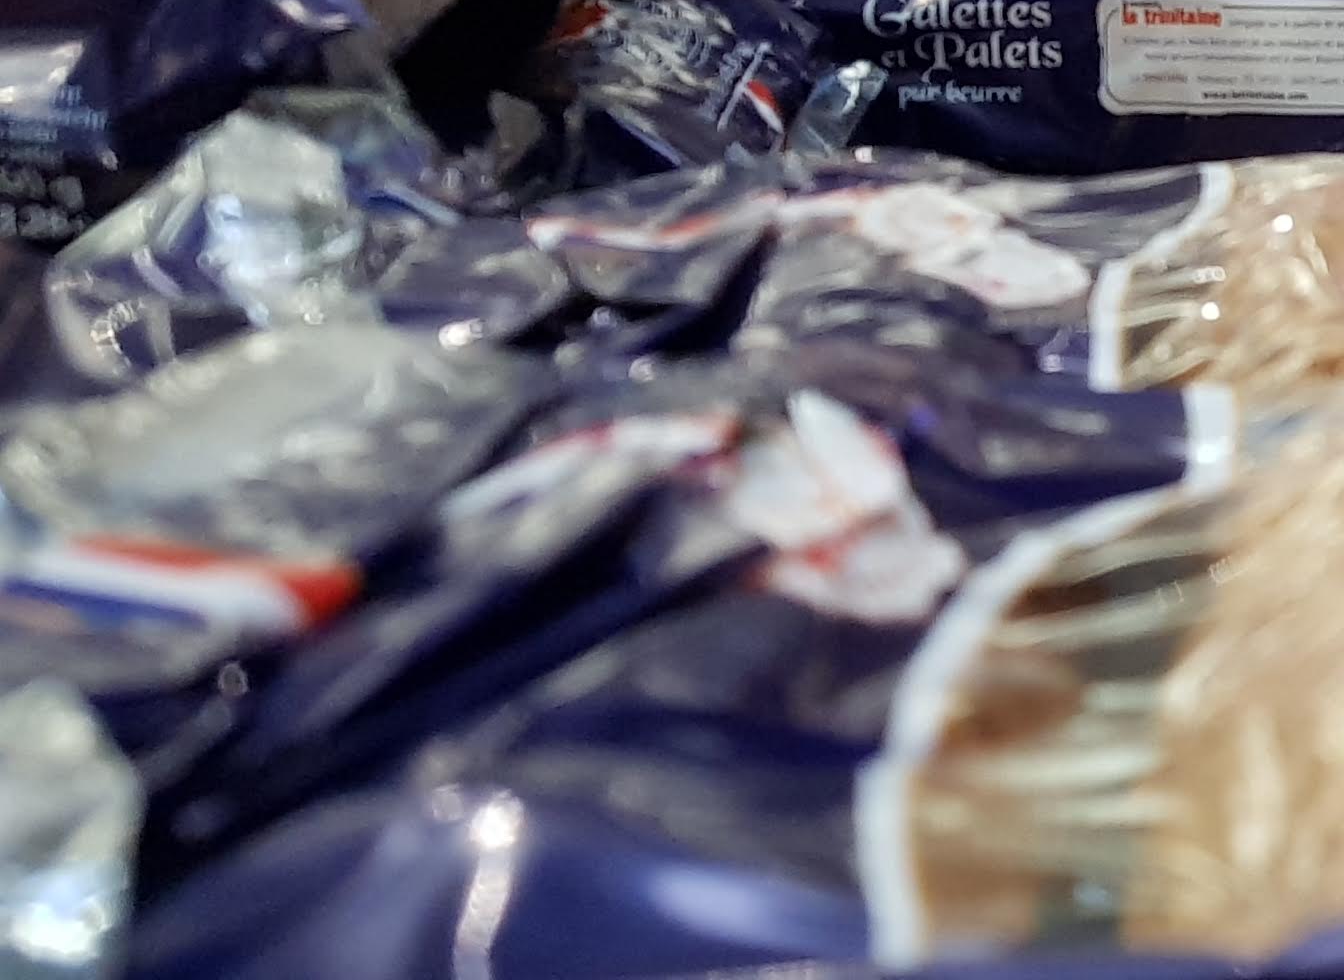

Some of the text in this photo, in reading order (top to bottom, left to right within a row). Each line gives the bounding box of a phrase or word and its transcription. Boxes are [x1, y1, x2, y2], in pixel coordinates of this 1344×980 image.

[880, 28, 1064, 84] et Palets
[945, 79, 1024, 104] beurre
